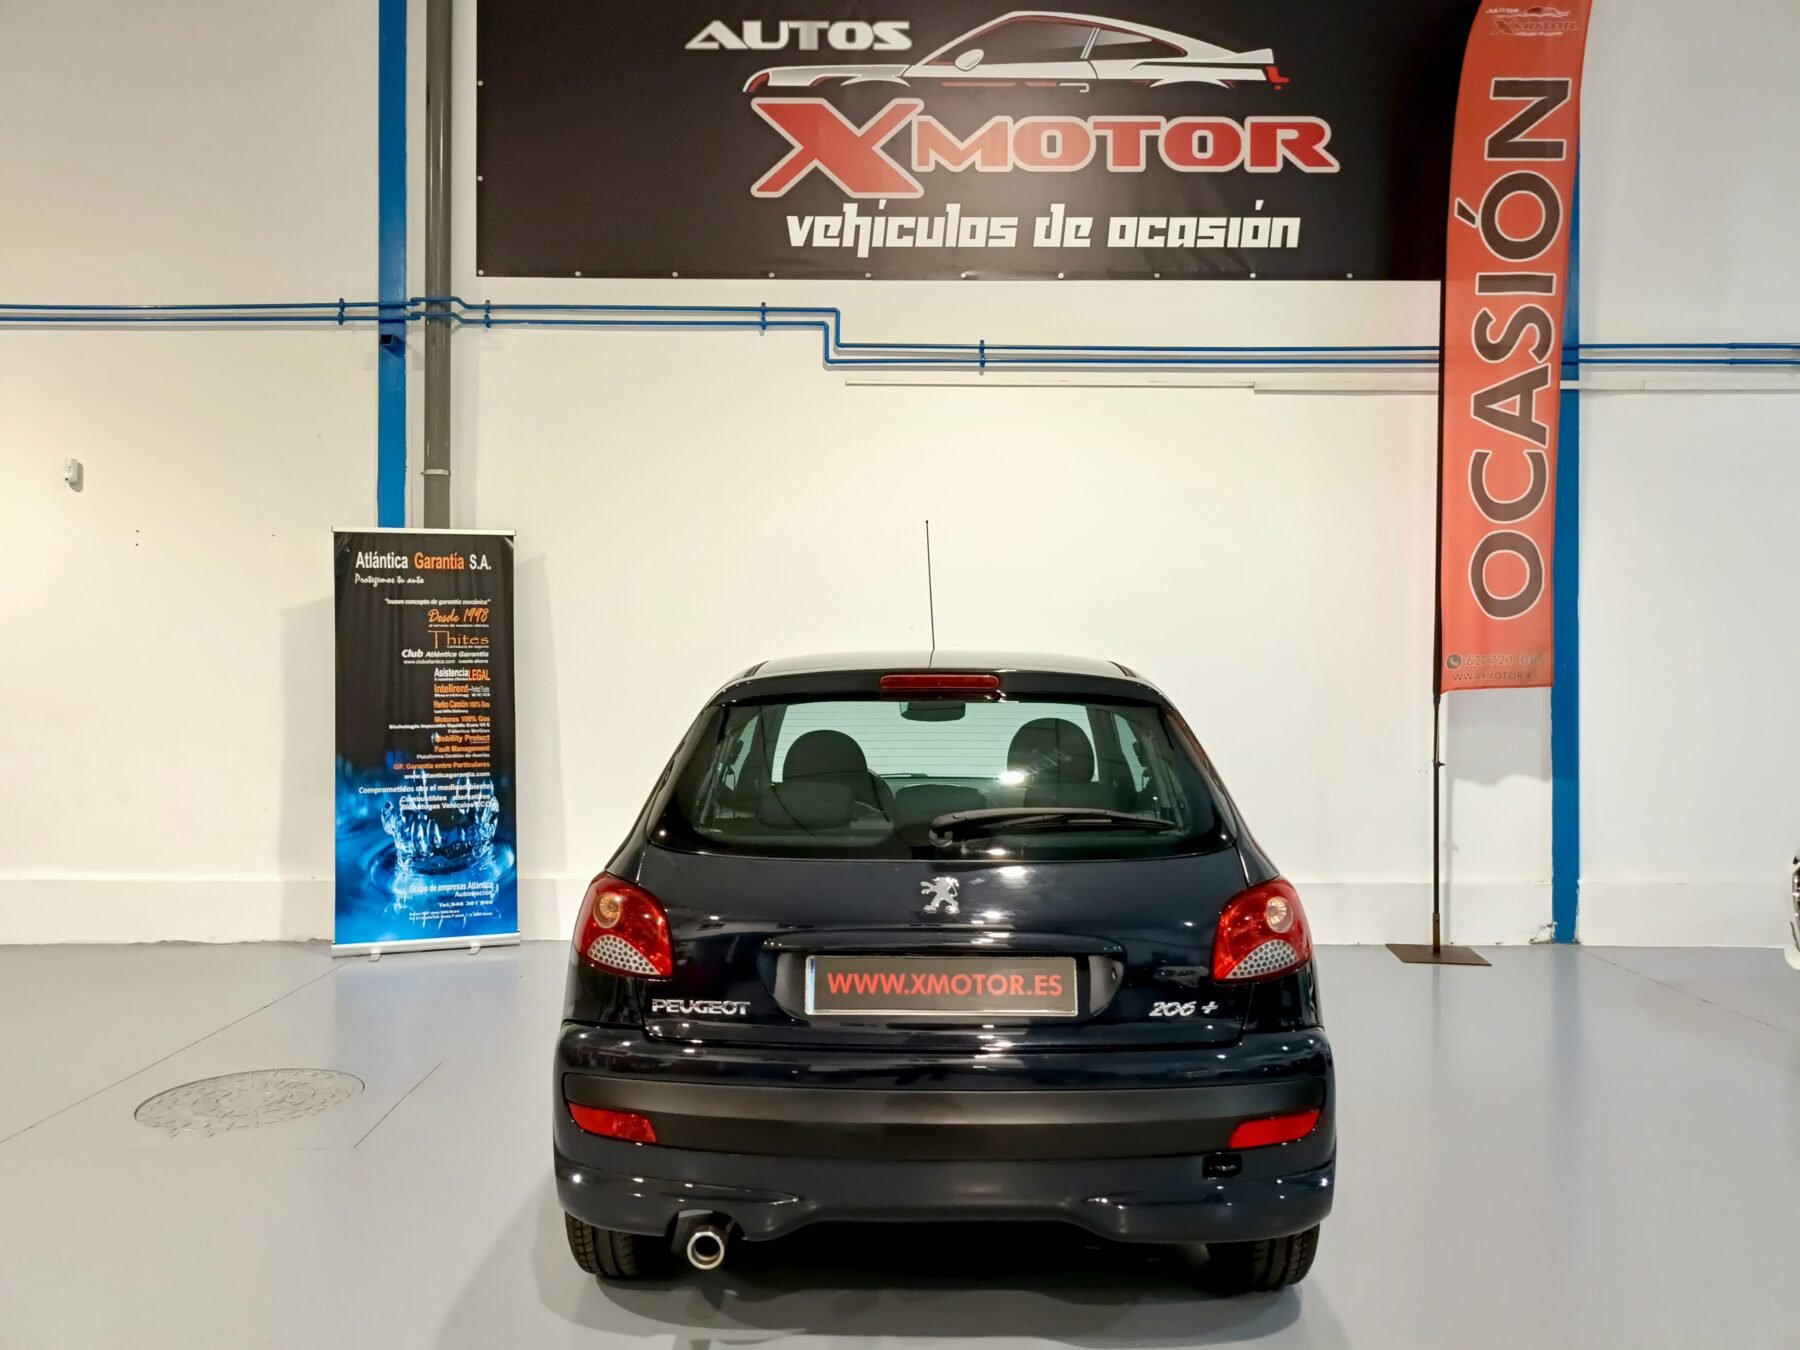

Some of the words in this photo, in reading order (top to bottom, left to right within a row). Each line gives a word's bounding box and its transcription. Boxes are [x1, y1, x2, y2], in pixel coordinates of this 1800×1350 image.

[685, 20, 913, 50] AUTOS
[750, 97, 1341, 198] XMOTOR
[786, 199, 1018, 258] vehículos
[1033, 203, 1093, 248] de
[1107, 199, 1301, 249] ocasión
[1455, 77, 1572, 621] OCASIÓN
[355, 551, 409, 569] Atlántica
[414, 552, 465, 570] Garantía
[469, 554, 492, 570] S.A.
[354, 573, 395, 587] Protegemos
[406, 576, 425, 584] auto
[428, 608, 460, 623] Desde
[463, 607, 490, 623] 1998
[428, 630, 490, 649] Thites
[401, 649, 424, 658] Club
[425, 650, 457, 658] Atlántica
[458, 650, 489, 658] Garantía
[464, 734, 490, 742] Protect
[359, 786, 415, 795] Comprometidos
[437, 884, 467, 892] empresas
[827, 972, 1063, 996] WWW.XMOTOR.ES
[652, 998, 751, 1015] PEUGEOT
[1149, 1001, 1197, 1016] 206
